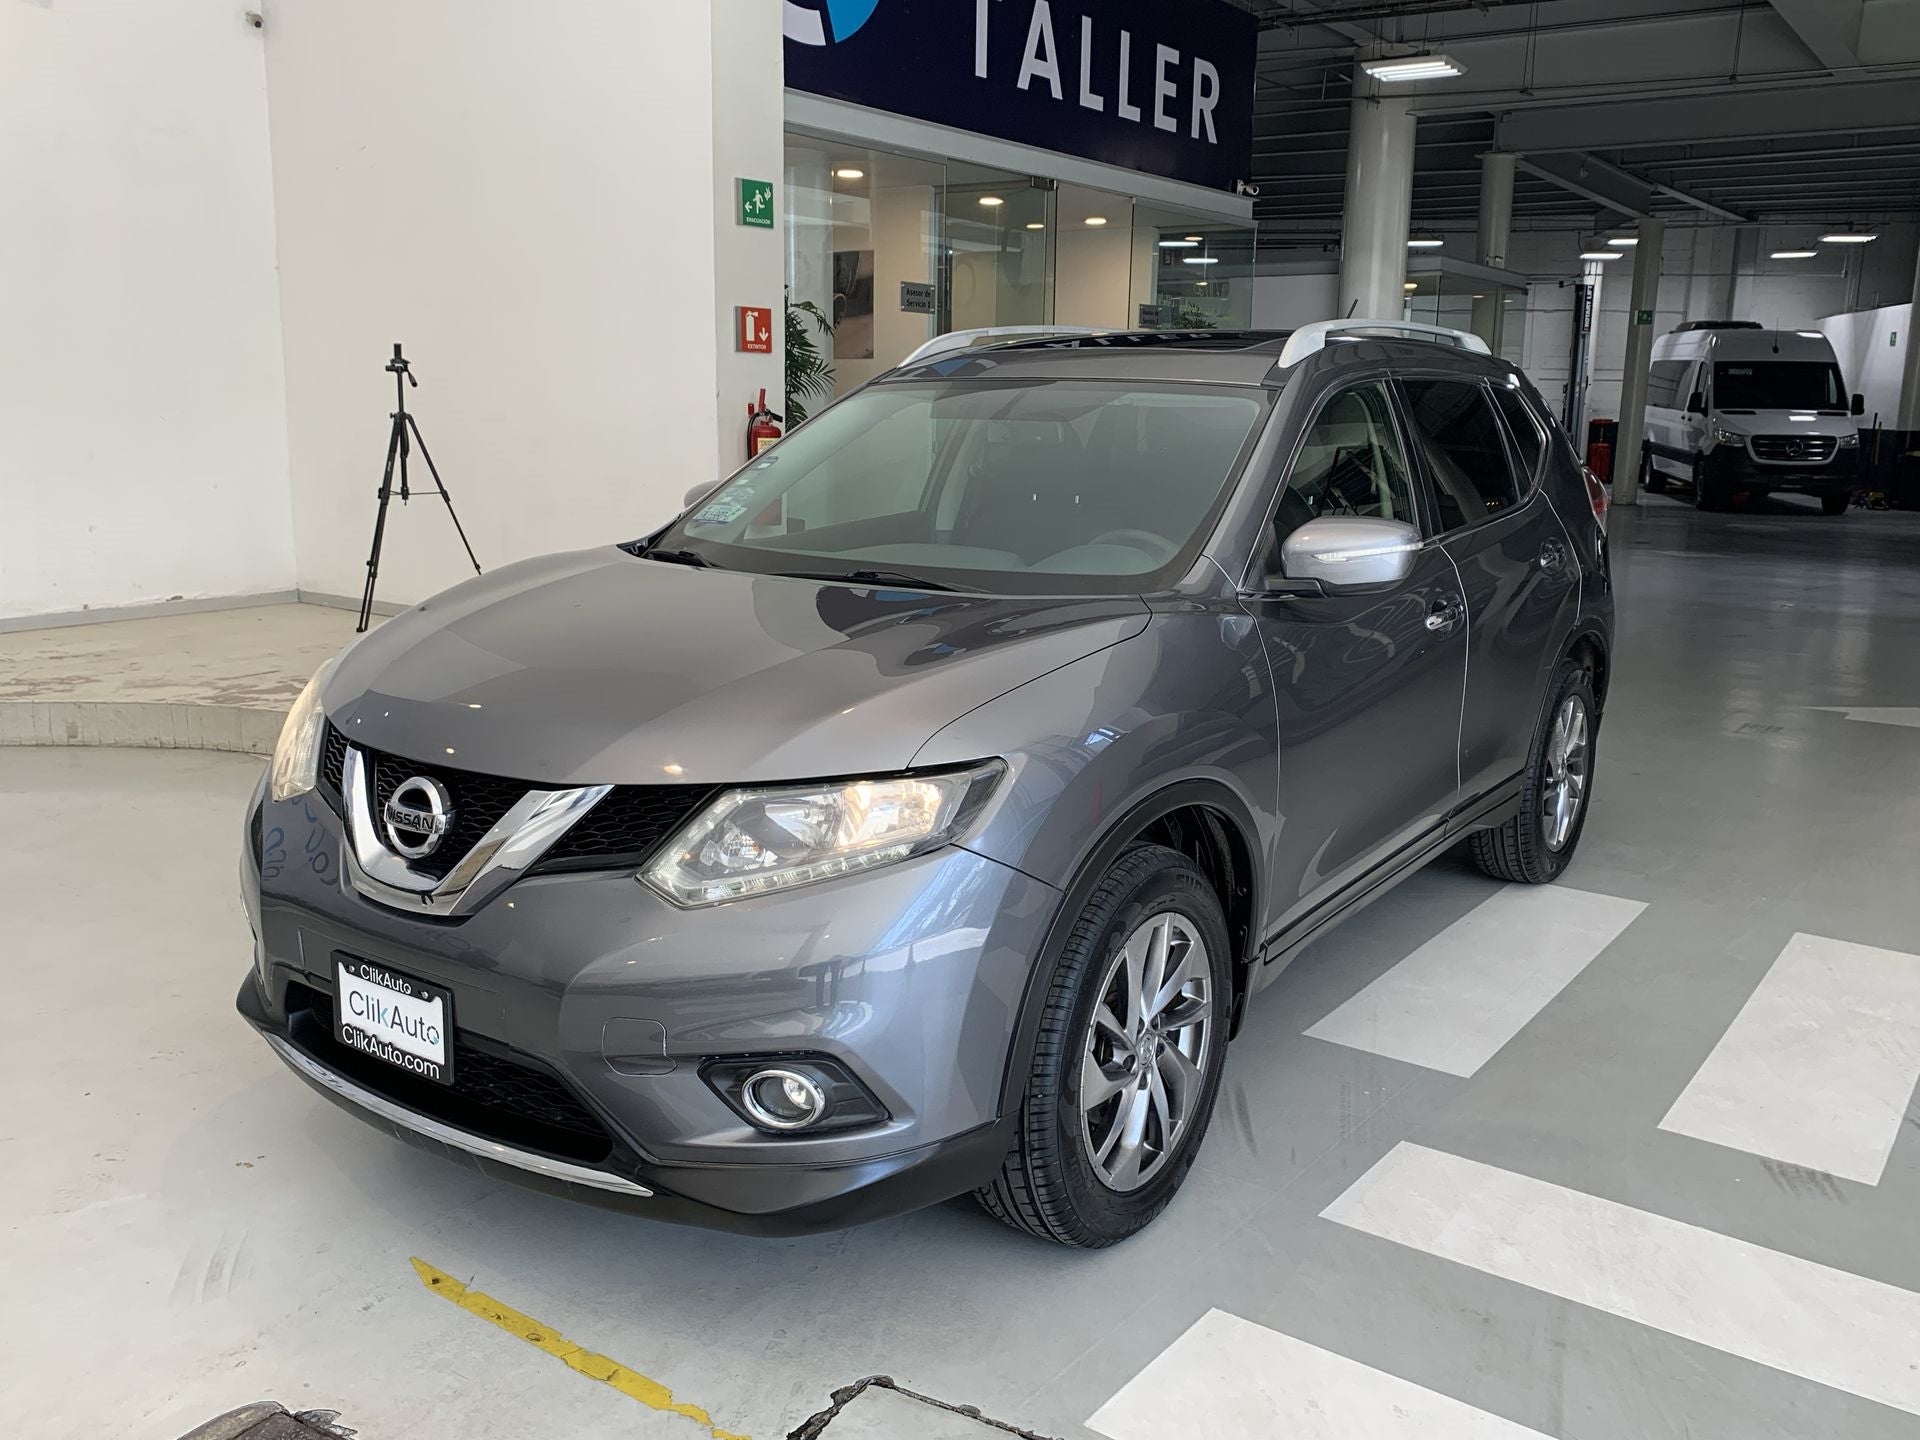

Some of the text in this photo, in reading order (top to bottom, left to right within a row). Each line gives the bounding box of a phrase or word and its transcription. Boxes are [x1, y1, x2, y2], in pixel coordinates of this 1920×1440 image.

[974, 0, 1221, 145] TALLER
[905, 287, 923, 297] Asesor
[906, 298, 927, 308] Servicio
[1584, 300, 1592, 328] ROTARY
[385, 803, 434, 831] NISSAN
[360, 964, 412, 995] ClikAuto
[349, 990, 440, 1046] ClikAuto
[342, 1025, 440, 1080] ClikAuto.com
